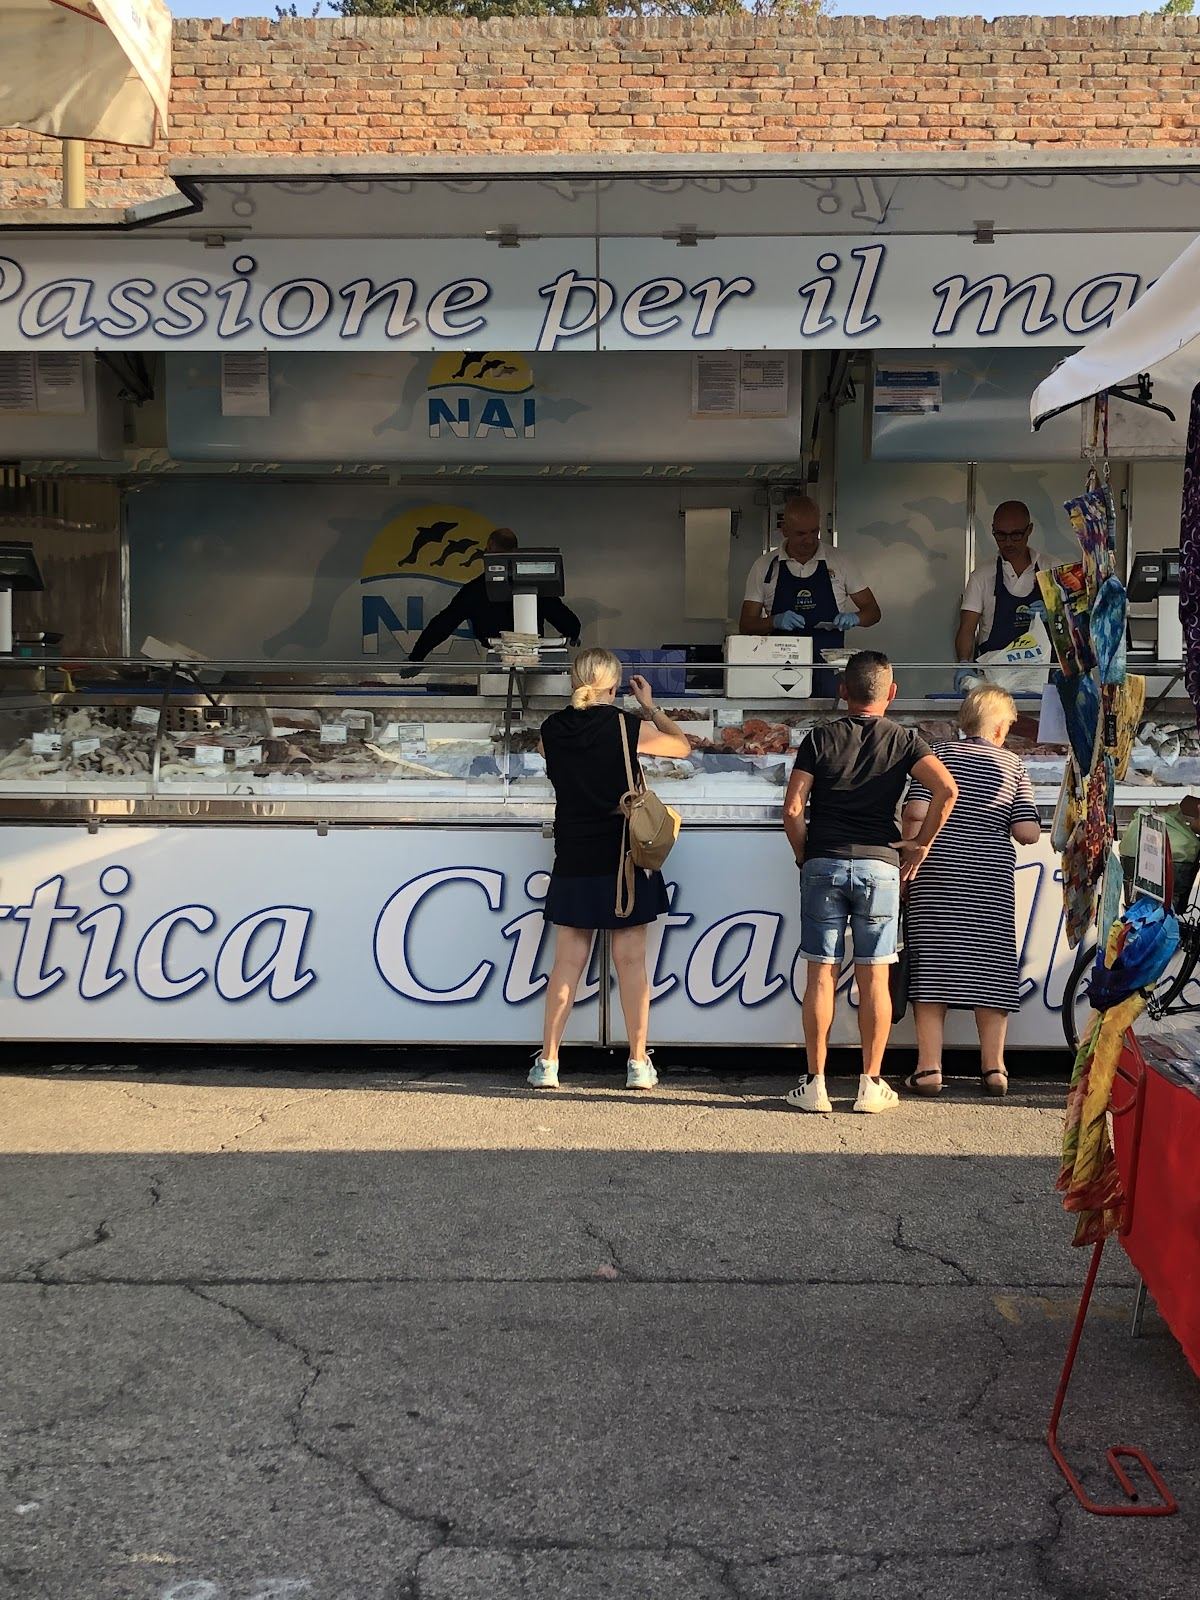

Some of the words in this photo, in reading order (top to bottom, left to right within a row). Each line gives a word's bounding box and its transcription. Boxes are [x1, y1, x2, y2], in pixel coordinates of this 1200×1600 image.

[538, 269, 754, 350] per
[798, 244, 886, 336] il
[932, 273, 1160, 336] ma
[429, 398, 535, 438] NAI
[1007, 647, 1042, 662] NAI
[0, 865, 318, 1001] tica
